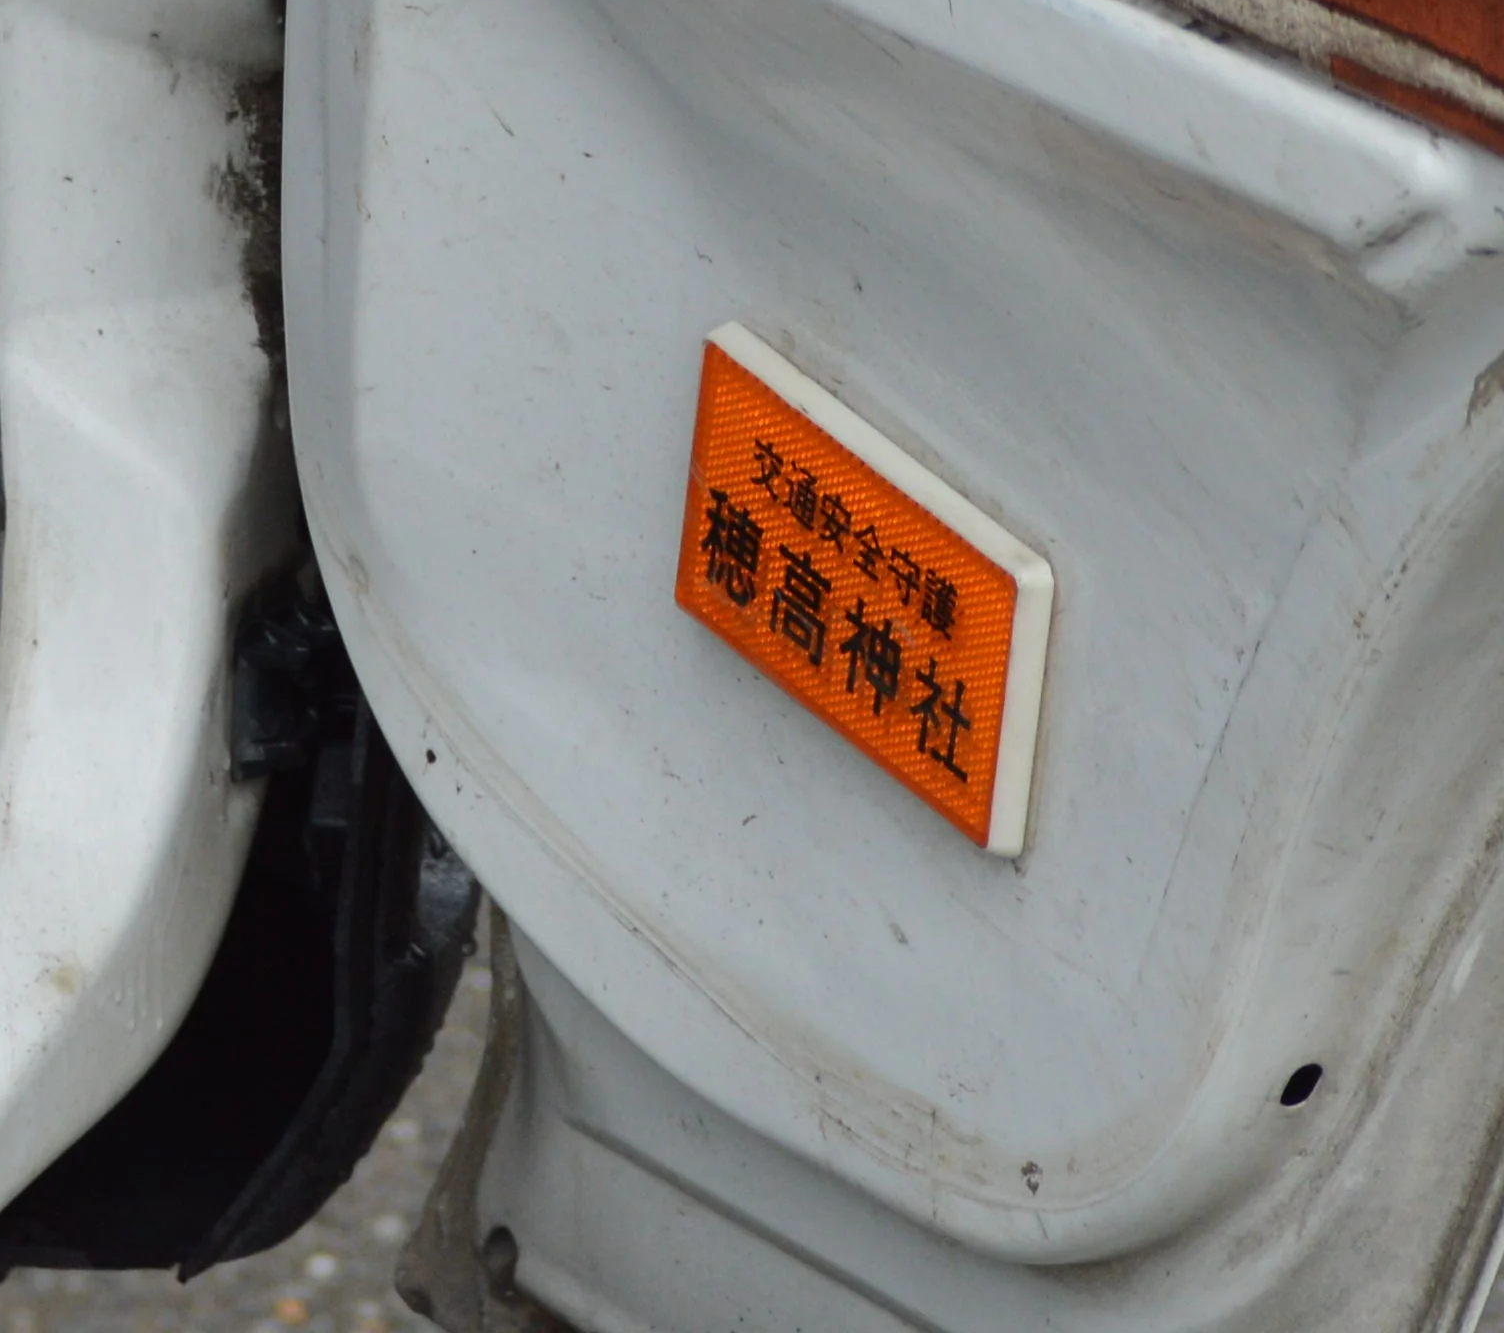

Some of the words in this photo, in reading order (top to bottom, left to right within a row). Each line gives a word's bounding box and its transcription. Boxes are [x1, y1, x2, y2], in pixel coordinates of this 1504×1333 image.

[701, 488, 971, 783] 穂高神社
[751, 437, 958, 641] 交通安全守護
